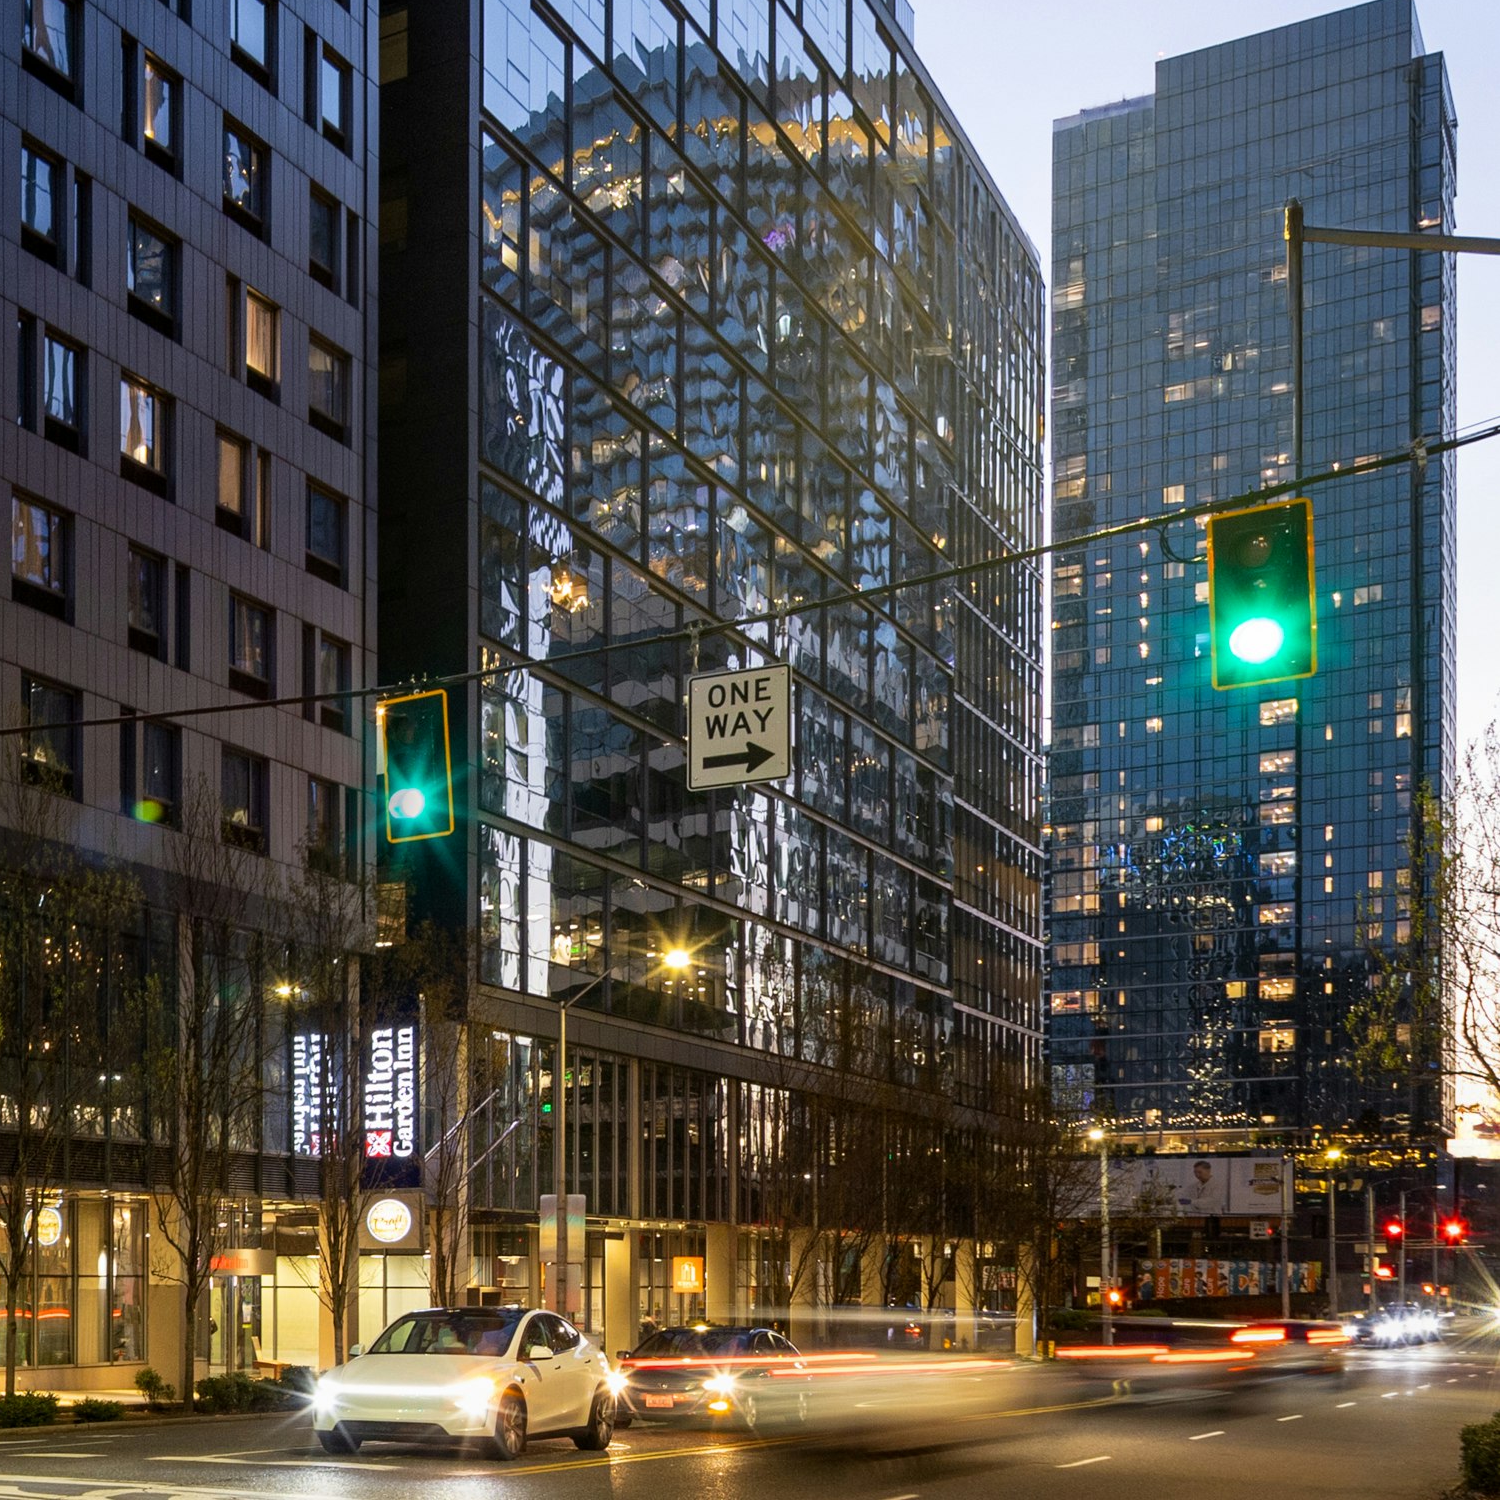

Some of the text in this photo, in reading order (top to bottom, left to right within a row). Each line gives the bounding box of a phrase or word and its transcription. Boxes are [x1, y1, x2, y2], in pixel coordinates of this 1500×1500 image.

[705, 707, 774, 740] WAY
[708, 677, 771, 709] ONE
[365, 1027, 393, 1130] Hilton
[393, 1026, 414, 1158] Garden Inn
